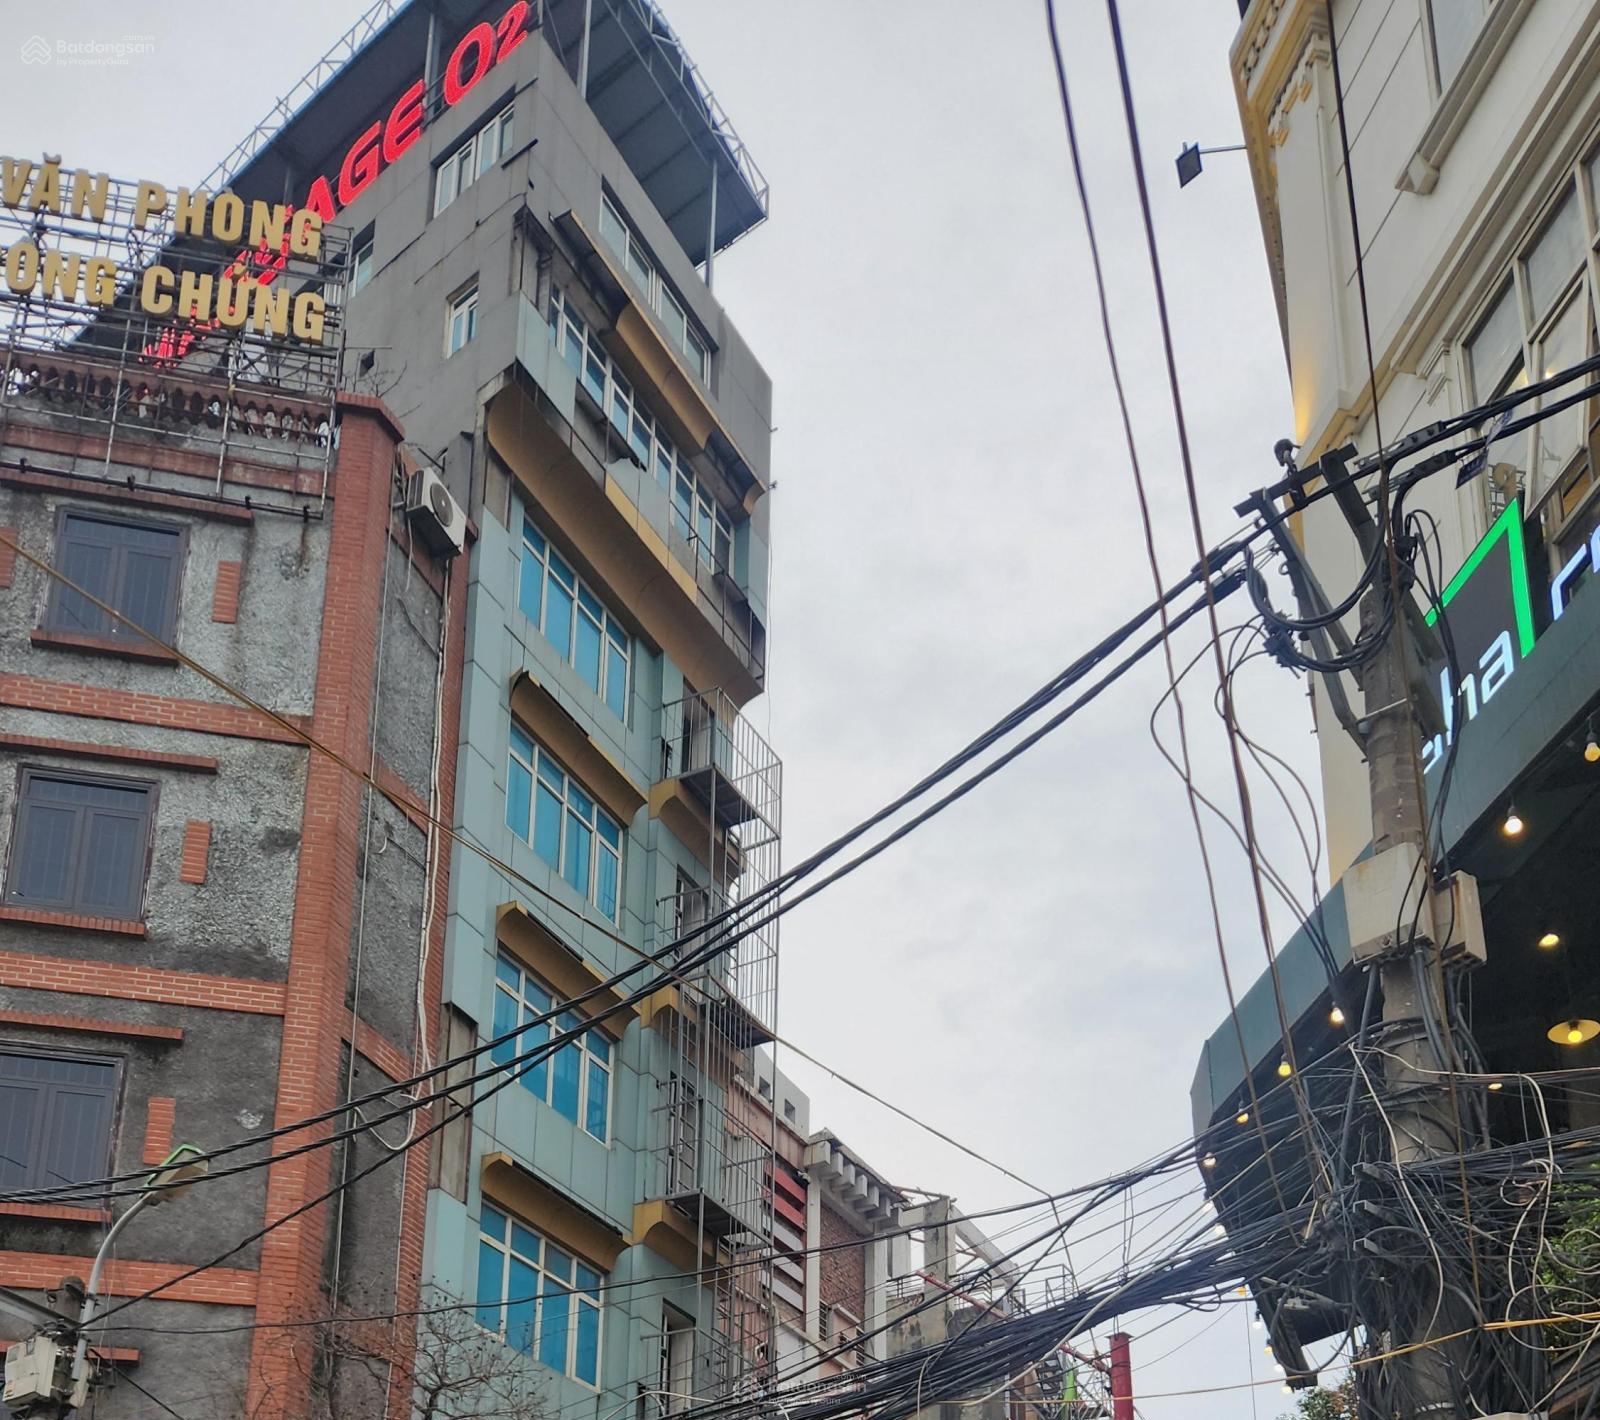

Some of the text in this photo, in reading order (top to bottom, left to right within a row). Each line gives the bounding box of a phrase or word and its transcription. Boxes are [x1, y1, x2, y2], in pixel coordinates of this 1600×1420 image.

[0, 152, 323, 262] VĂN PHÒNG
[0, 235, 325, 344] ÔNG CHỨNG
